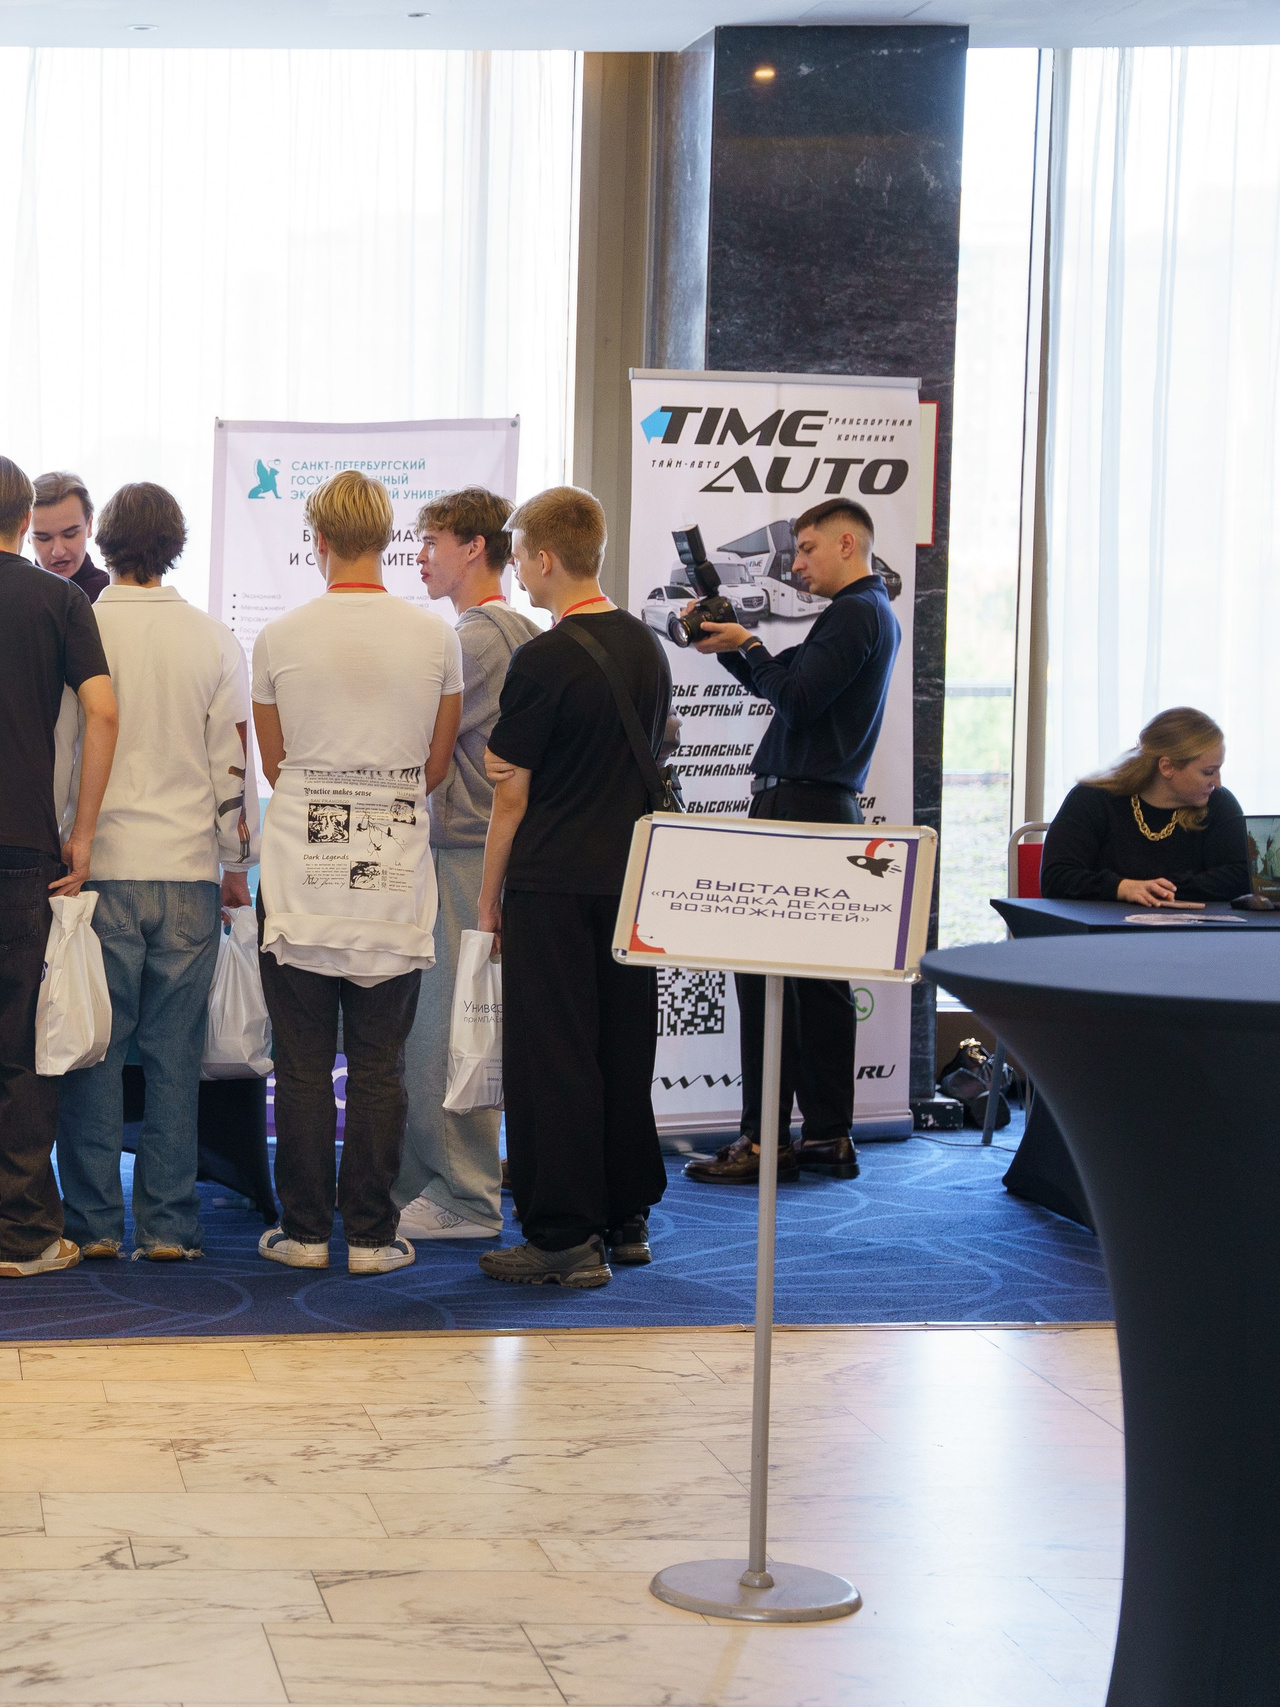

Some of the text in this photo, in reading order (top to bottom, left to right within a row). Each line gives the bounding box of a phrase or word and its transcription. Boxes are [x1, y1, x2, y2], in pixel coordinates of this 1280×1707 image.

[660, 405, 829, 447] TIME
[828, 417, 912, 426] ТРАНСПОРТНАЯ
[837, 434, 895, 442] КОМПАНИЯ
[291, 458, 426, 470] САНКТ-ПЕТЕРБУРГСКИЙ
[699, 456, 909, 495] AUTO
[676, 701, 743, 717] ФОРТНЫЙ
[332, 788, 353, 796] makes
[687, 797, 750, 813] ВЫСОКИЙ
[695, 879, 851, 899] ВЫСТАВКА
[651, 889, 893, 913] «ПЛОЩАДКА ДЕЛОВЫХ
[669, 902, 870, 923] ВОЗМОЖНОСТЕЙ»
